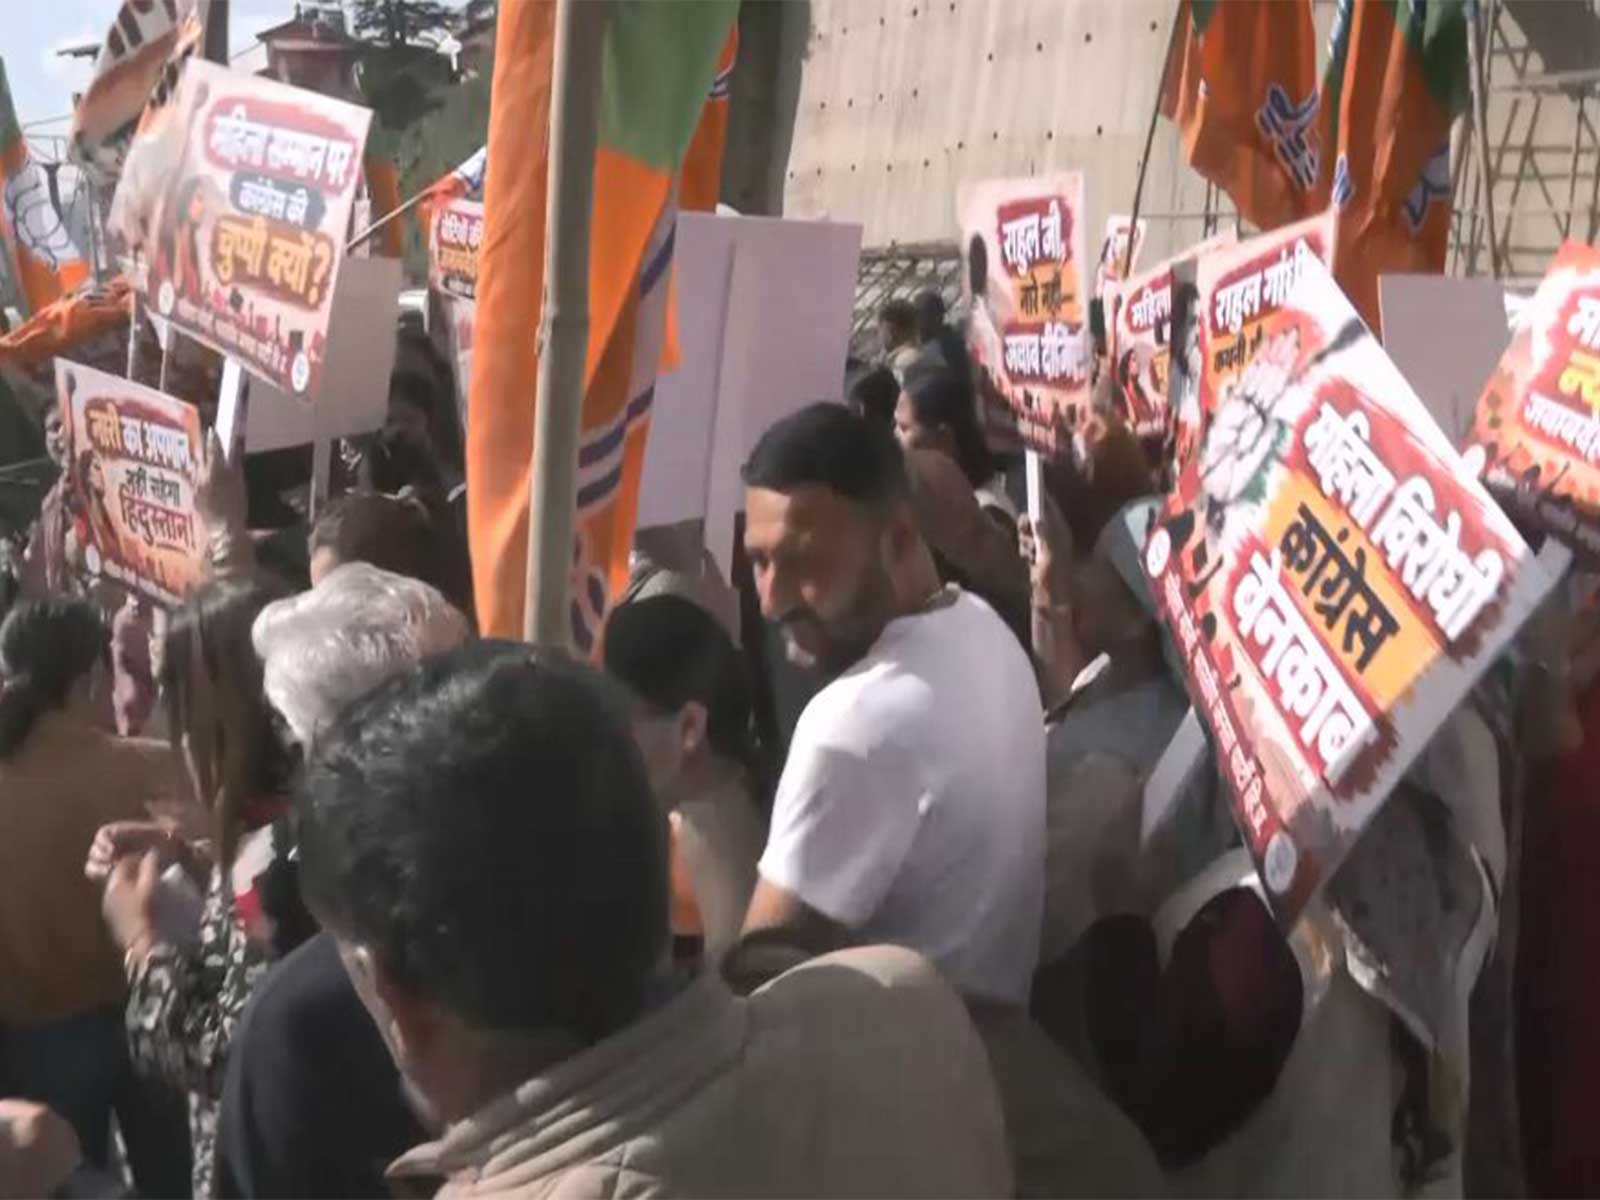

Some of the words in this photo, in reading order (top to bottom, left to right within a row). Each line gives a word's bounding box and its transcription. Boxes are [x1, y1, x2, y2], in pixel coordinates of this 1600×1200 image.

[209, 104, 265, 167] महिला
[326, 139, 356, 186] पर
[1214, 270, 1262, 333] राहुल
[1280, 502, 1400, 674] कांग्रेस
[1304, 400, 1398, 532] महिला
[1370, 475, 1504, 641] विरोधी
[1233, 543, 1379, 780] बेनकाब
